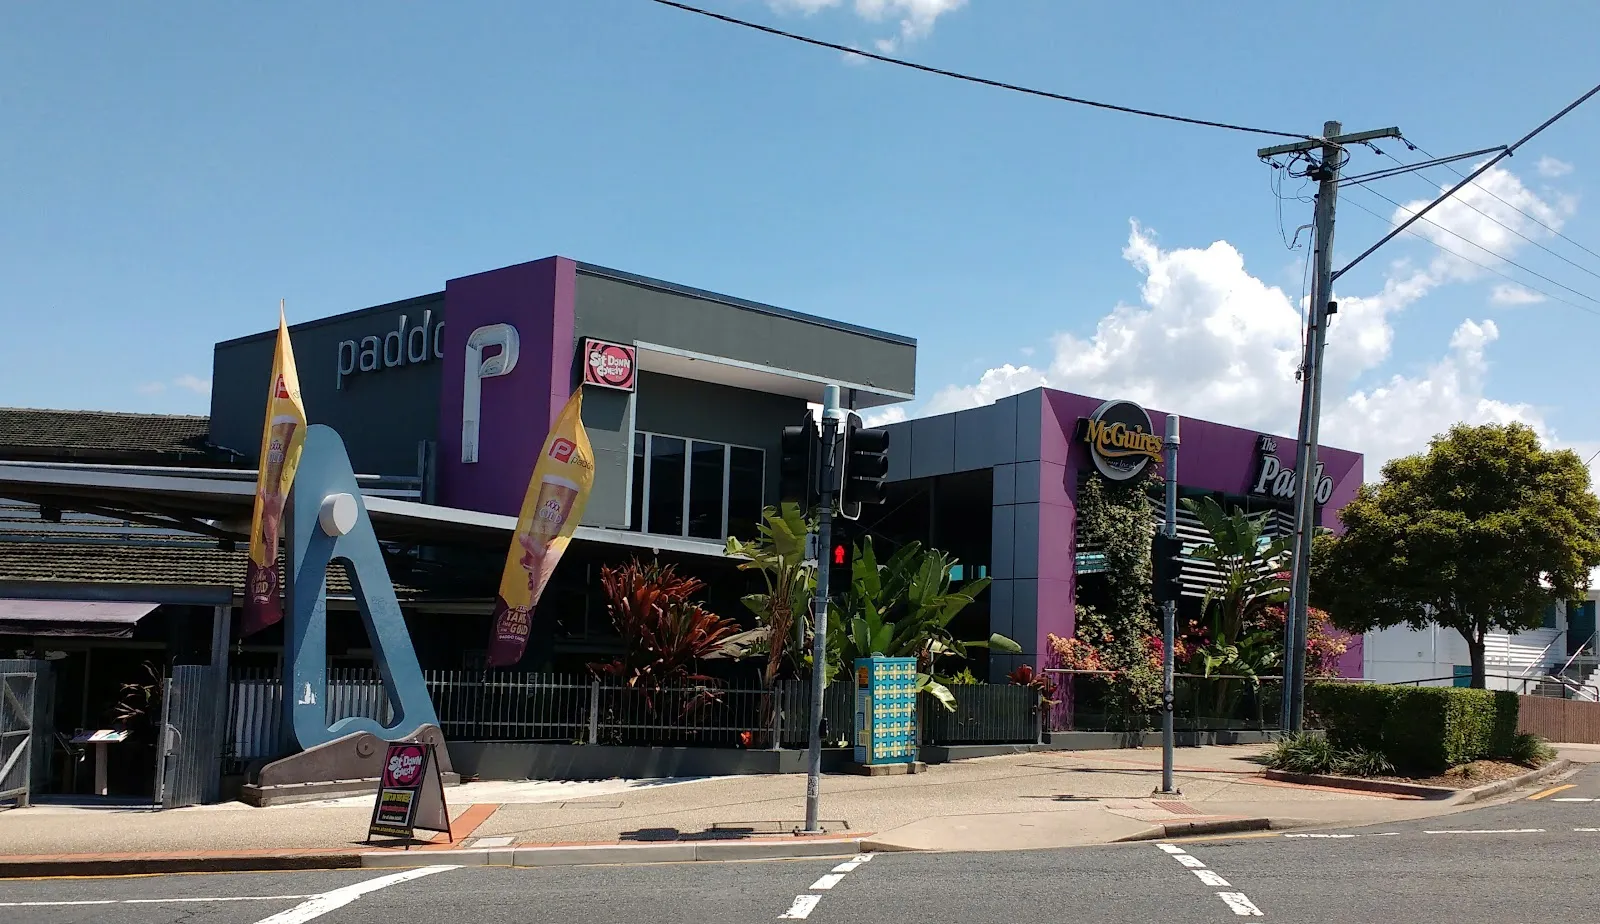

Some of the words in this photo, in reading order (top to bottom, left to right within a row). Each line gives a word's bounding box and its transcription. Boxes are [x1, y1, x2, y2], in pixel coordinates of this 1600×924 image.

[461, 322, 520, 464] P
[549, 438, 574, 462] P
[1084, 419, 1163, 454] McGuires
[1261, 437, 1277, 452] The
